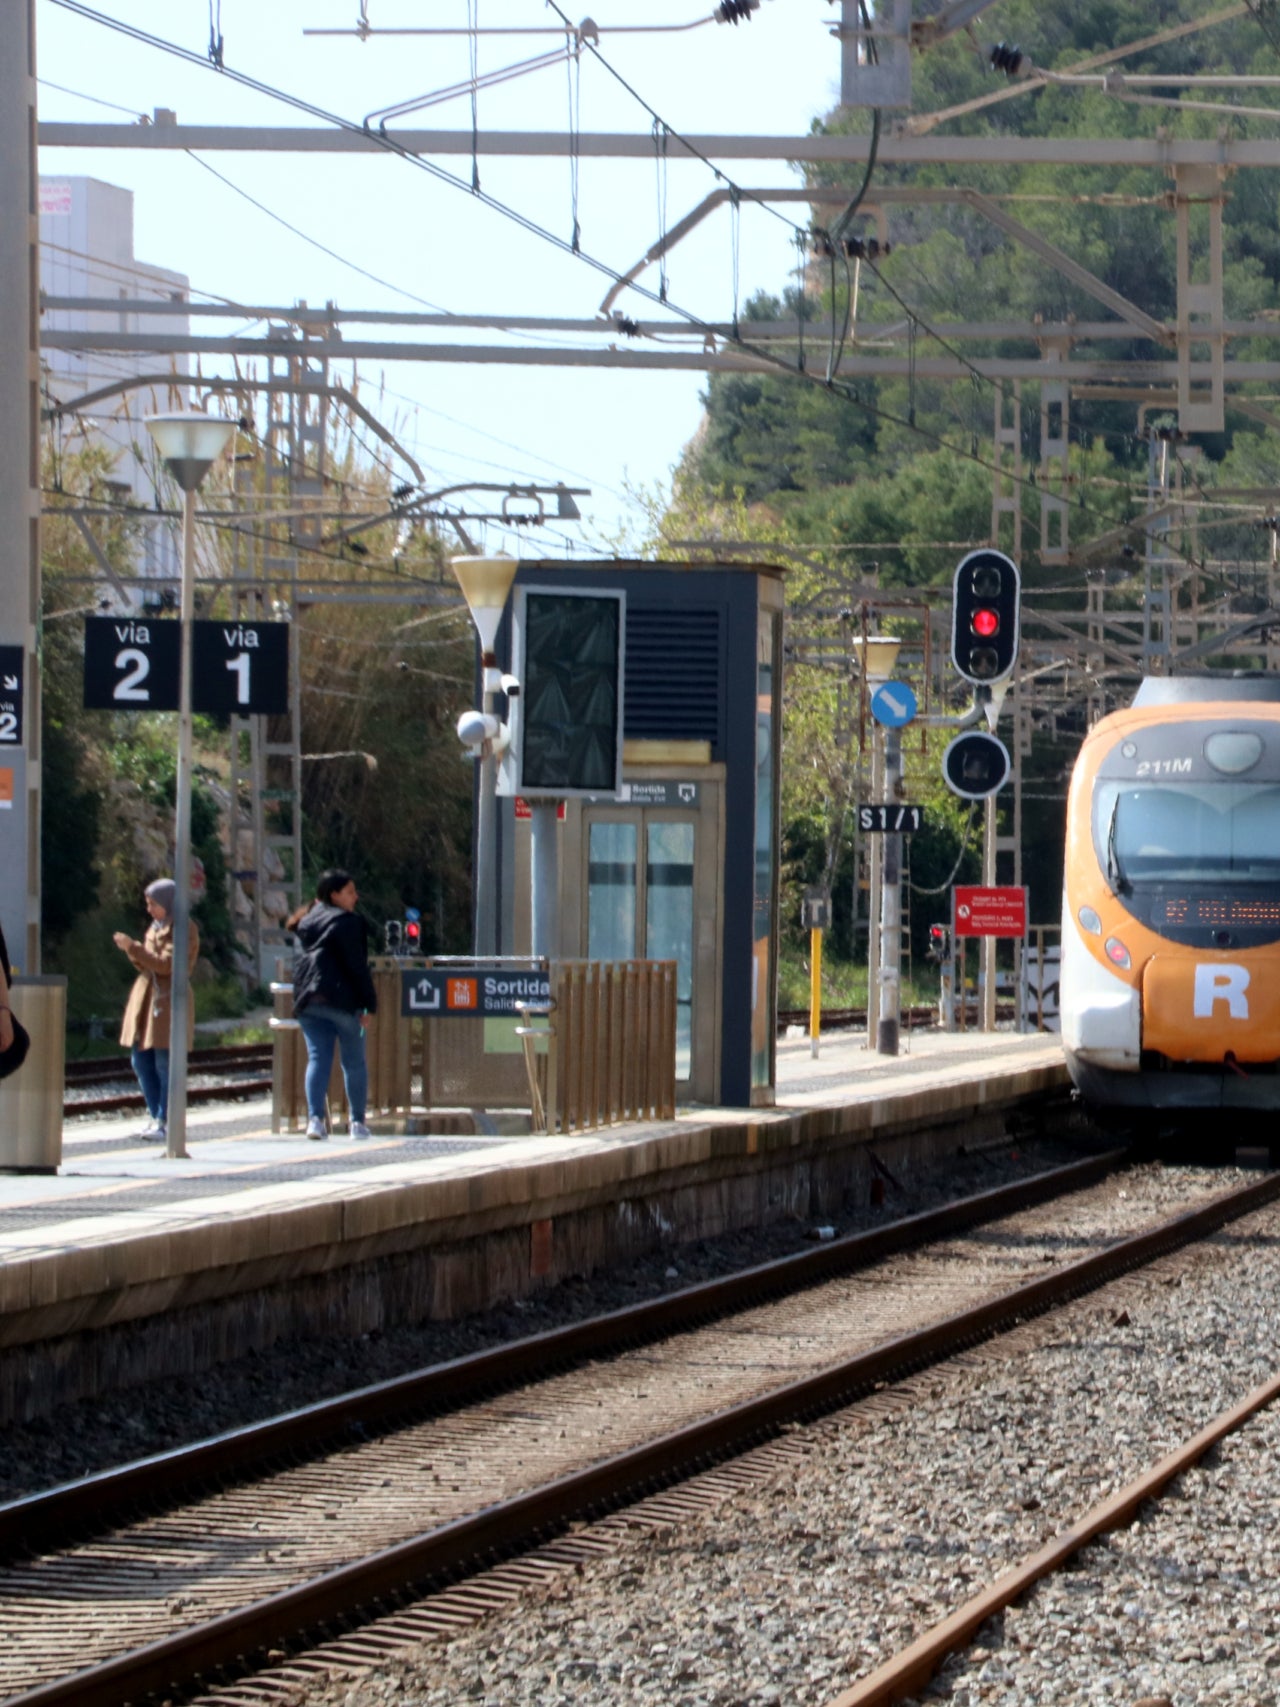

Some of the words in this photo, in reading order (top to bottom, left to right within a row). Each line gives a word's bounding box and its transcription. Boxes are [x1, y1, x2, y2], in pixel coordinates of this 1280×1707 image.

[114, 621, 151, 644] via
[223, 625, 260, 648] via
[113, 648, 150, 701] 2
[225, 652, 251, 705] 1
[0, 712, 17, 740] 2
[1135, 757, 1193, 777] 211M
[484, 976, 550, 996] Sortida
[1193, 962, 1251, 1020] R
